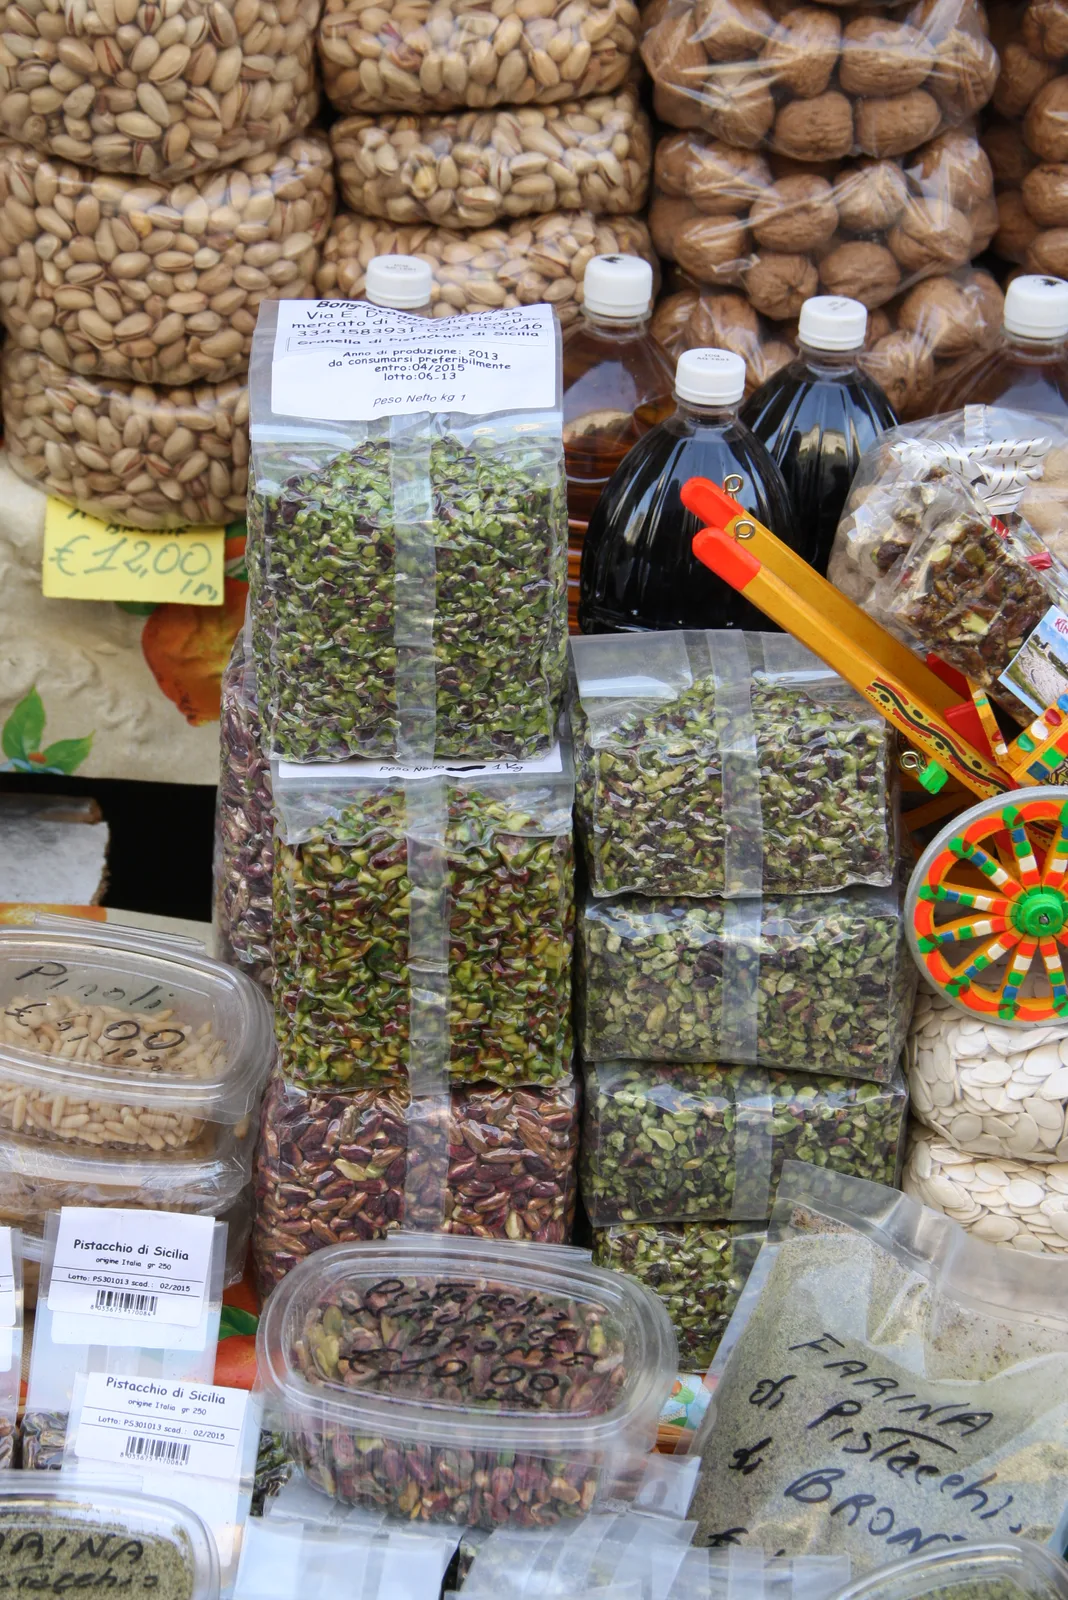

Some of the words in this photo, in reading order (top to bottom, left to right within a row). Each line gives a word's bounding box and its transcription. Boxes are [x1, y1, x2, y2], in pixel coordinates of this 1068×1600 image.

[292, 319, 366, 329] mercato
[373, 316, 388, 325] di
[307, 311, 334, 320] Via
[341, 311, 357, 319] E.
[298, 329, 331, 337] 334
[328, 359, 343, 367] da
[348, 357, 413, 365] consumarsi
[418, 356, 511, 370] preferibilmente
[393, 348, 462, 356] produzione:
[468, 349, 499, 361] 2013
[373, 396, 402, 407] peso
[406, 393, 437, 403] Netto
[441, 393, 455, 402] kg
[73, 1238, 133, 1254] Pistacchio
[137, 1244, 149, 1255] di
[153, 1246, 189, 1261] Sicilia
[95, 1257, 119, 1266] origine
[122, 1259, 142, 1267] Italia
[158, 1263, 172, 1271] 250
[68, 1273, 90, 1282] Lotto:
[92, 1275, 129, 1285] PS301013
[159, 1282, 191, 1292] 02/2015
[106, 1376, 168, 1396] Pistacchio
[172, 1387, 184, 1398] di
[188, 1390, 226, 1404] Sicilia
[749, 1374, 797, 1410] di
[788, 1333, 994, 1437] FARINA
[128, 1399, 153, 1408] origine
[155, 1401, 176, 1411] Italia
[193, 1407, 207, 1416] 250
[98, 1415, 121, 1425] Lotto:
[124, 1419, 162, 1431] PS301013
[193, 1429, 225, 1440] 02/2015
[784, 1468, 968, 1554] BRON
